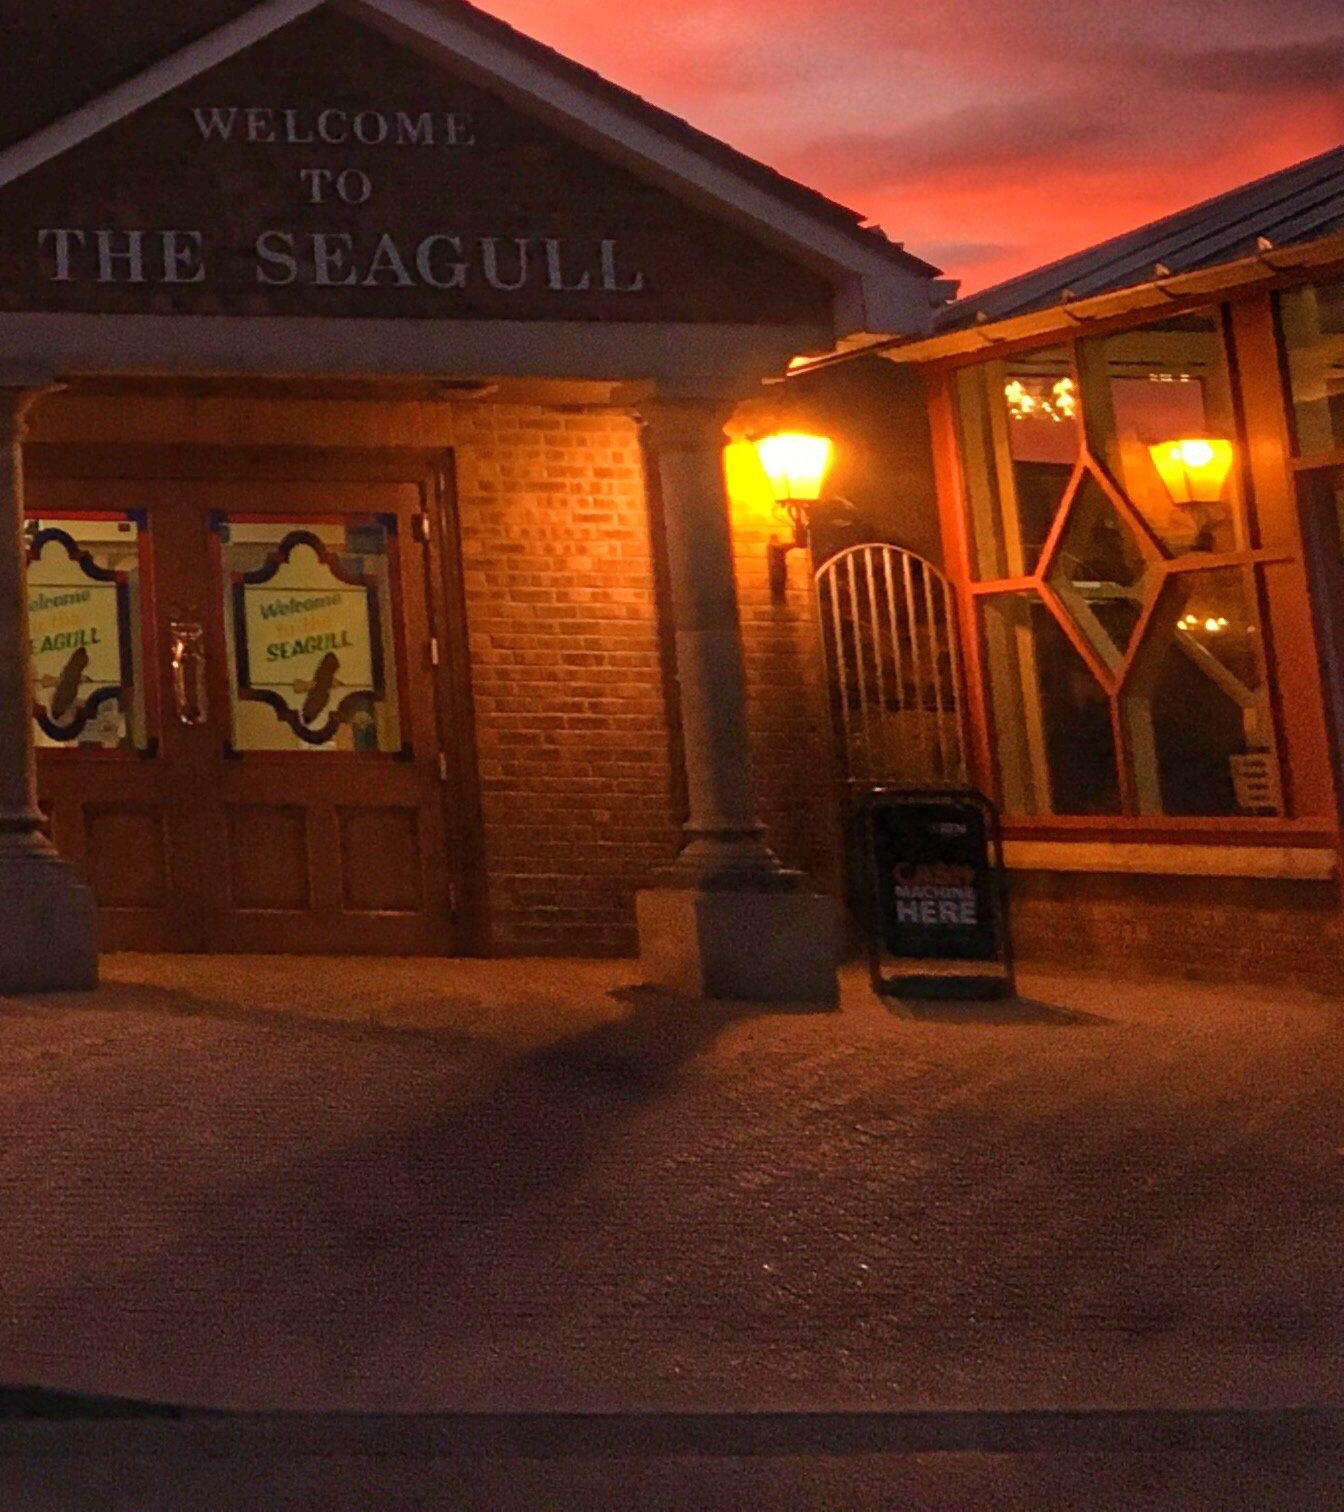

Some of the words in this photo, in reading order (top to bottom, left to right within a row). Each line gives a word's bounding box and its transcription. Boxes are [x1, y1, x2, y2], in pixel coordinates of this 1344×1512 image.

[191, 107, 477, 147] WELCOME
[299, 168, 373, 205] TO
[37, 228, 207, 284] THE
[255, 232, 645, 292] SEAGULL
[28, 589, 91, 612] elcome
[259, 592, 341, 621] Welcome
[30, 627, 102, 654] AGULL
[266, 630, 353, 662] SEAGULL
[894, 885, 977, 899] MACHINE
[896, 899, 979, 925] HERE
